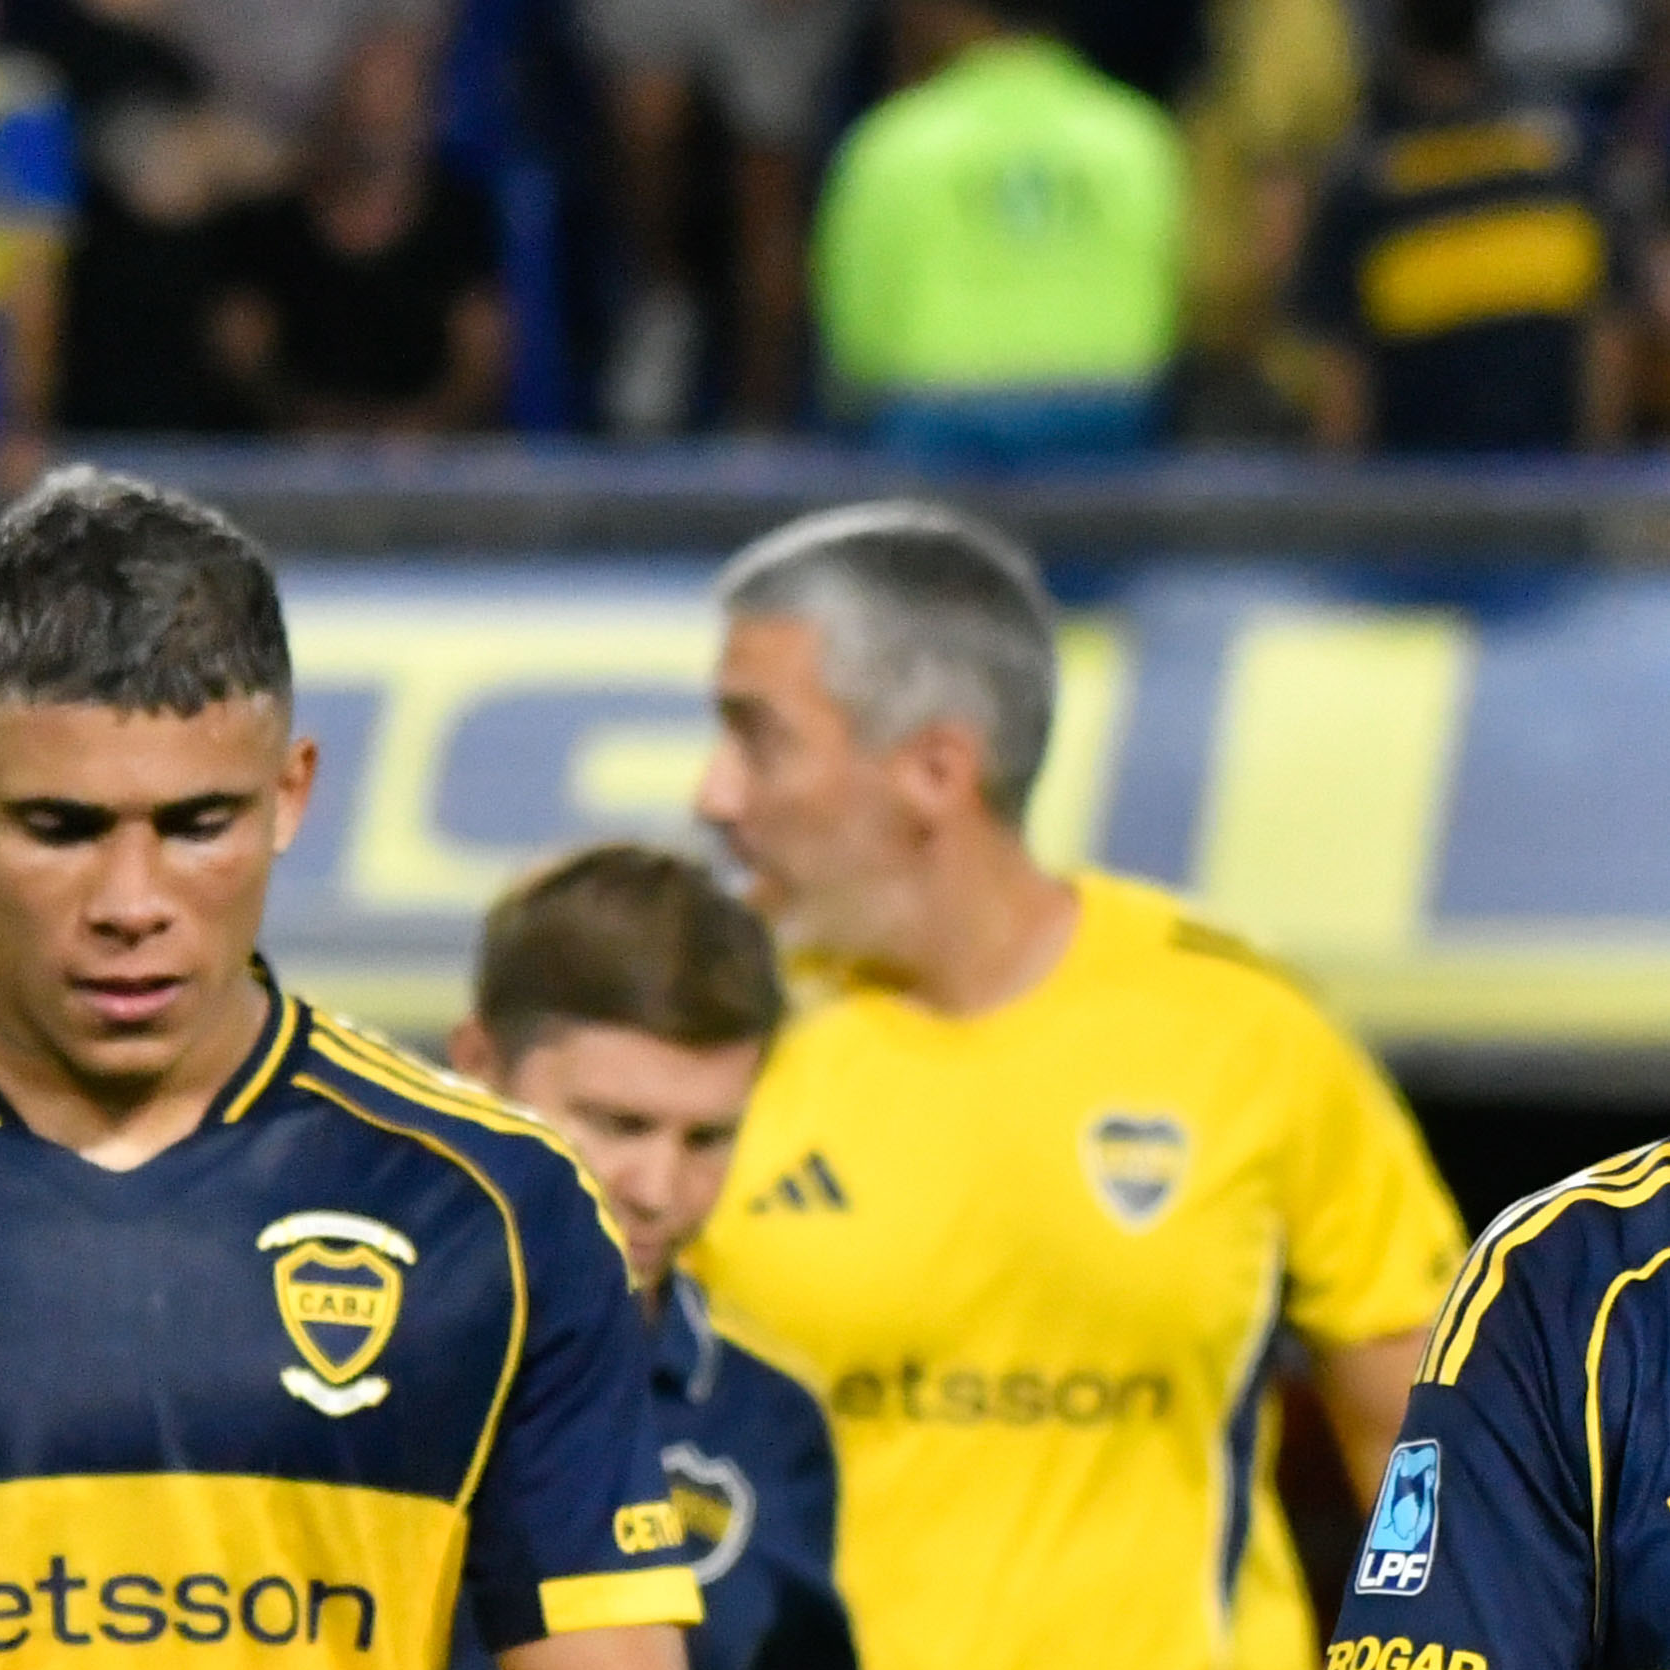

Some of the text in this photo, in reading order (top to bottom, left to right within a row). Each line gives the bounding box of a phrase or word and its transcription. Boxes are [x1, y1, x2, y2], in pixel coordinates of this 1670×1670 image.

[299, 1292, 377, 1319] CABJ
[829, 1354, 1173, 1428] etsson
[1359, 1551, 1428, 1589] LPF
